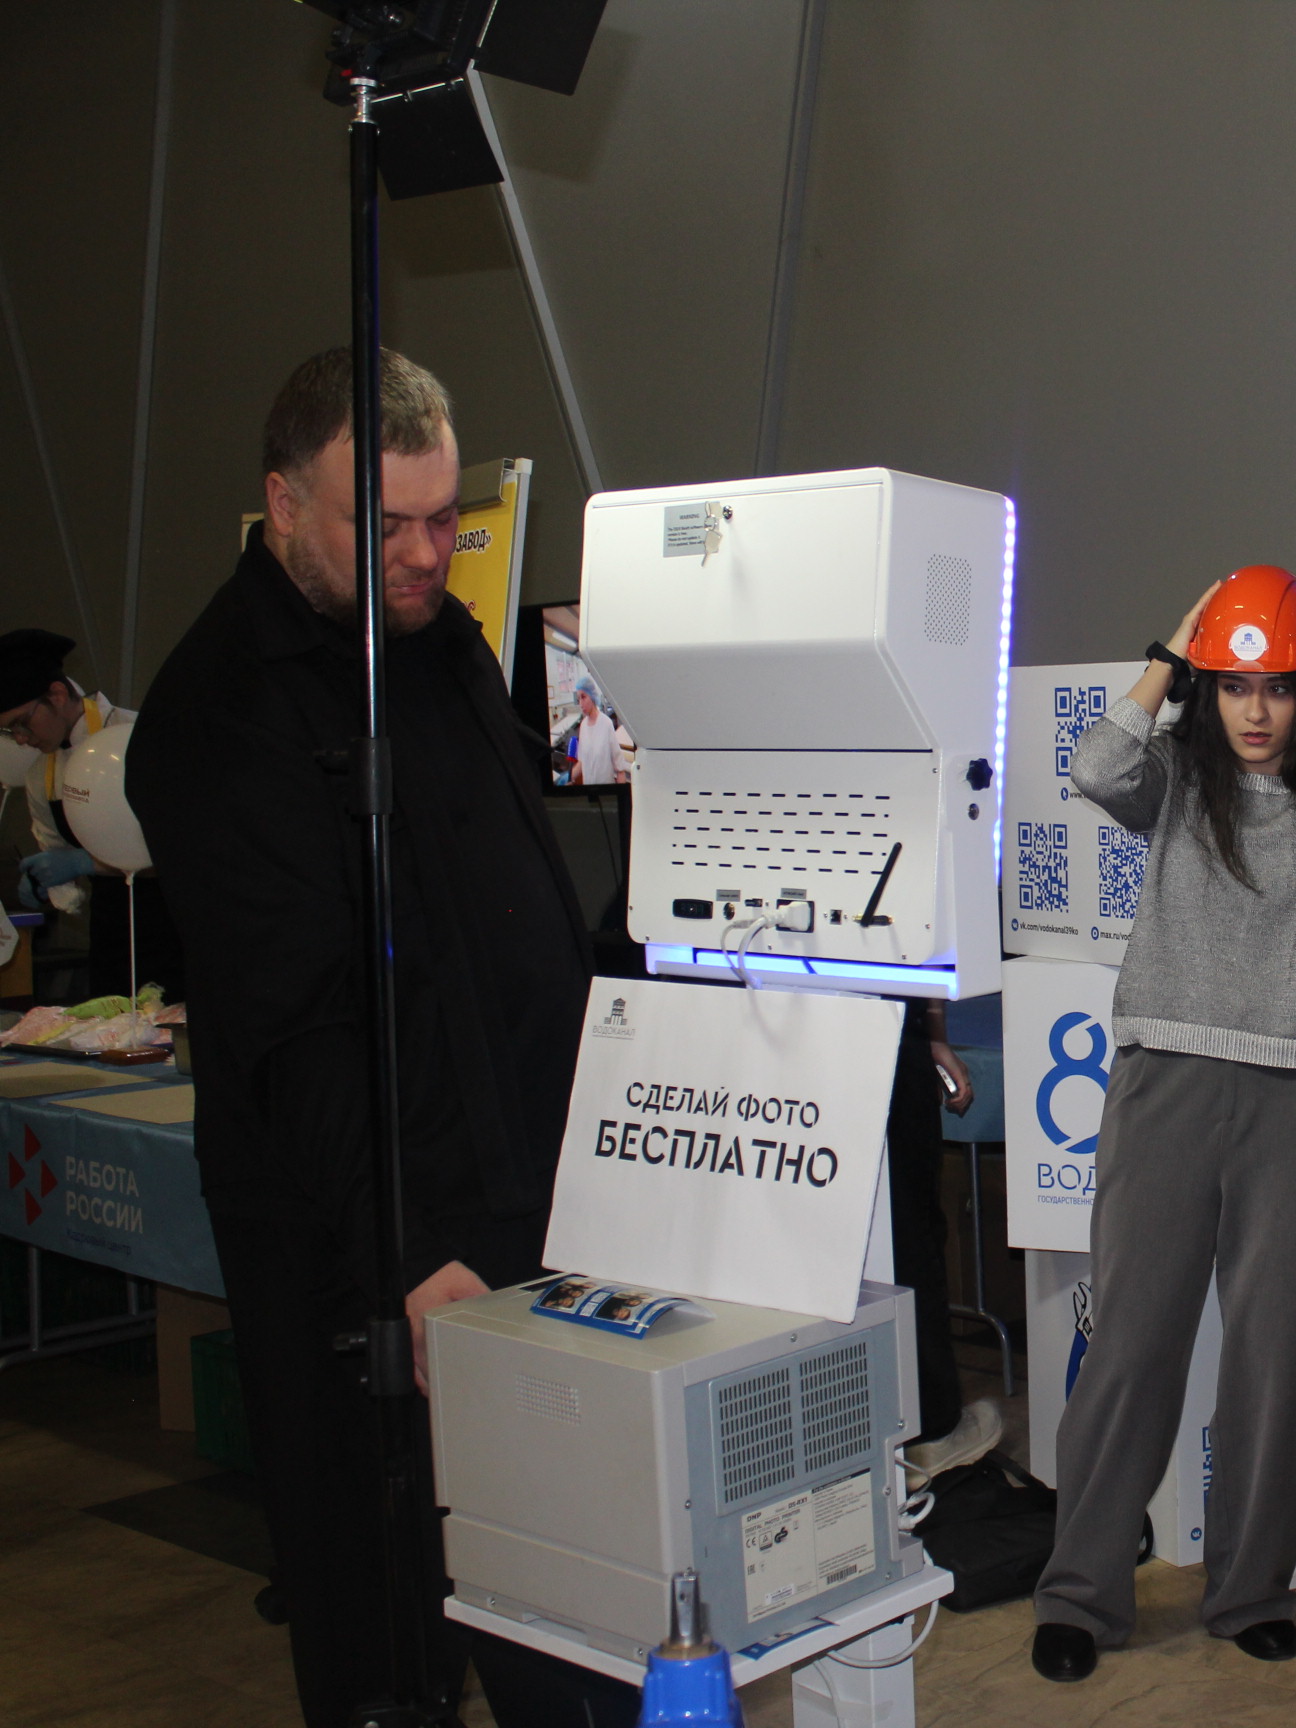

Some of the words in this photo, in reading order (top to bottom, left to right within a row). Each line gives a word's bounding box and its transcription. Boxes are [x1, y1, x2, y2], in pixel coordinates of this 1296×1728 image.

[626, 1081, 730, 1117] СДЕЛАЙ
[736, 1093, 820, 1128] ФОТО
[594, 1119, 838, 1188] БЕСПЛАТНО
[65, 1155, 139, 1198] РАБОТА
[65, 1190, 143, 1234] РОССИИ
